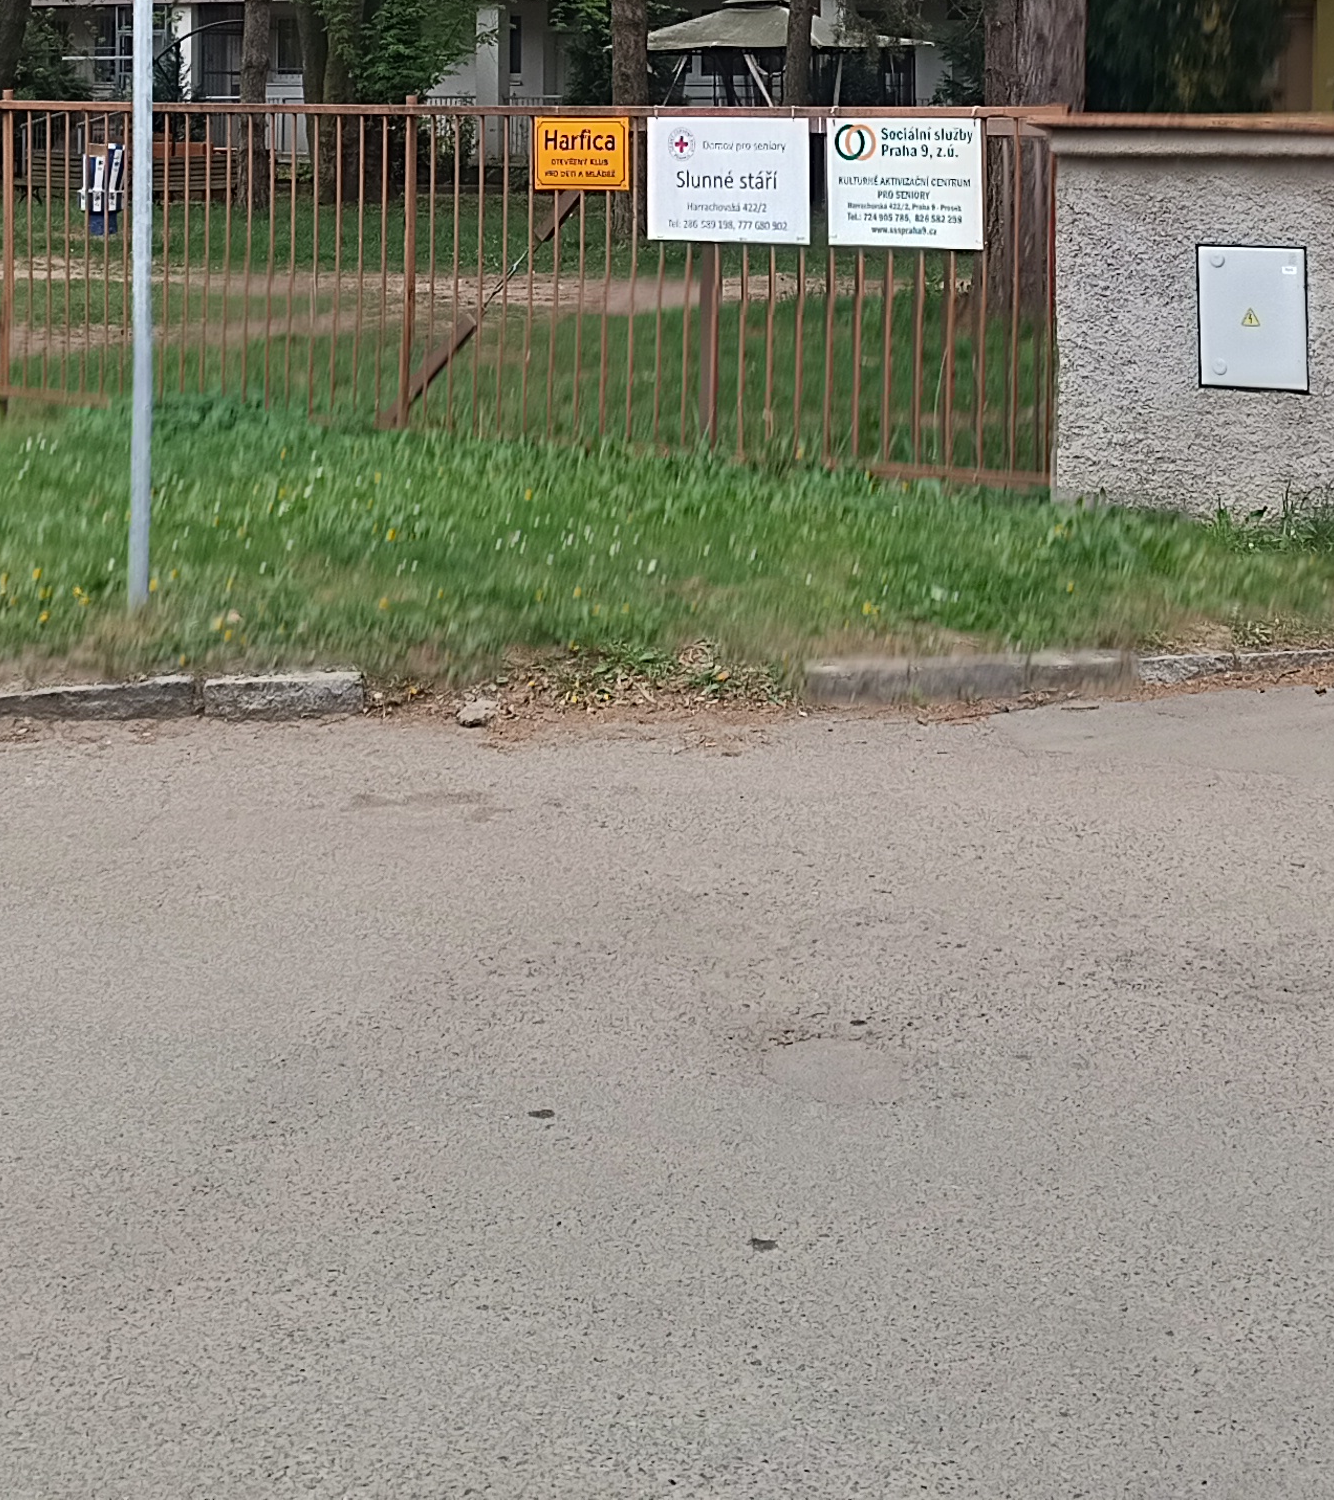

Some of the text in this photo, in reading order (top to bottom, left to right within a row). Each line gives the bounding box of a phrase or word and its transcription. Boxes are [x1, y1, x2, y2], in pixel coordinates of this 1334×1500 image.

[544, 128, 616, 151] Harfica
[880, 126, 973, 144] Sociální služby
[702, 141, 786, 153] Domov pro seniory
[881, 144, 959, 159] Praha 9, z.ú.
[676, 169, 778, 190] Slunné stáří
[930, 178, 971, 187] CENTRUM
[877, 190, 930, 200] PRO SENIORY
[687, 202, 767, 214] Harrachovská 422/2
[912, 203, 930, 211] Praha
[683, 219, 698, 229] 286
[737, 220, 753, 230] 777
[772, 221, 788, 231] 902
